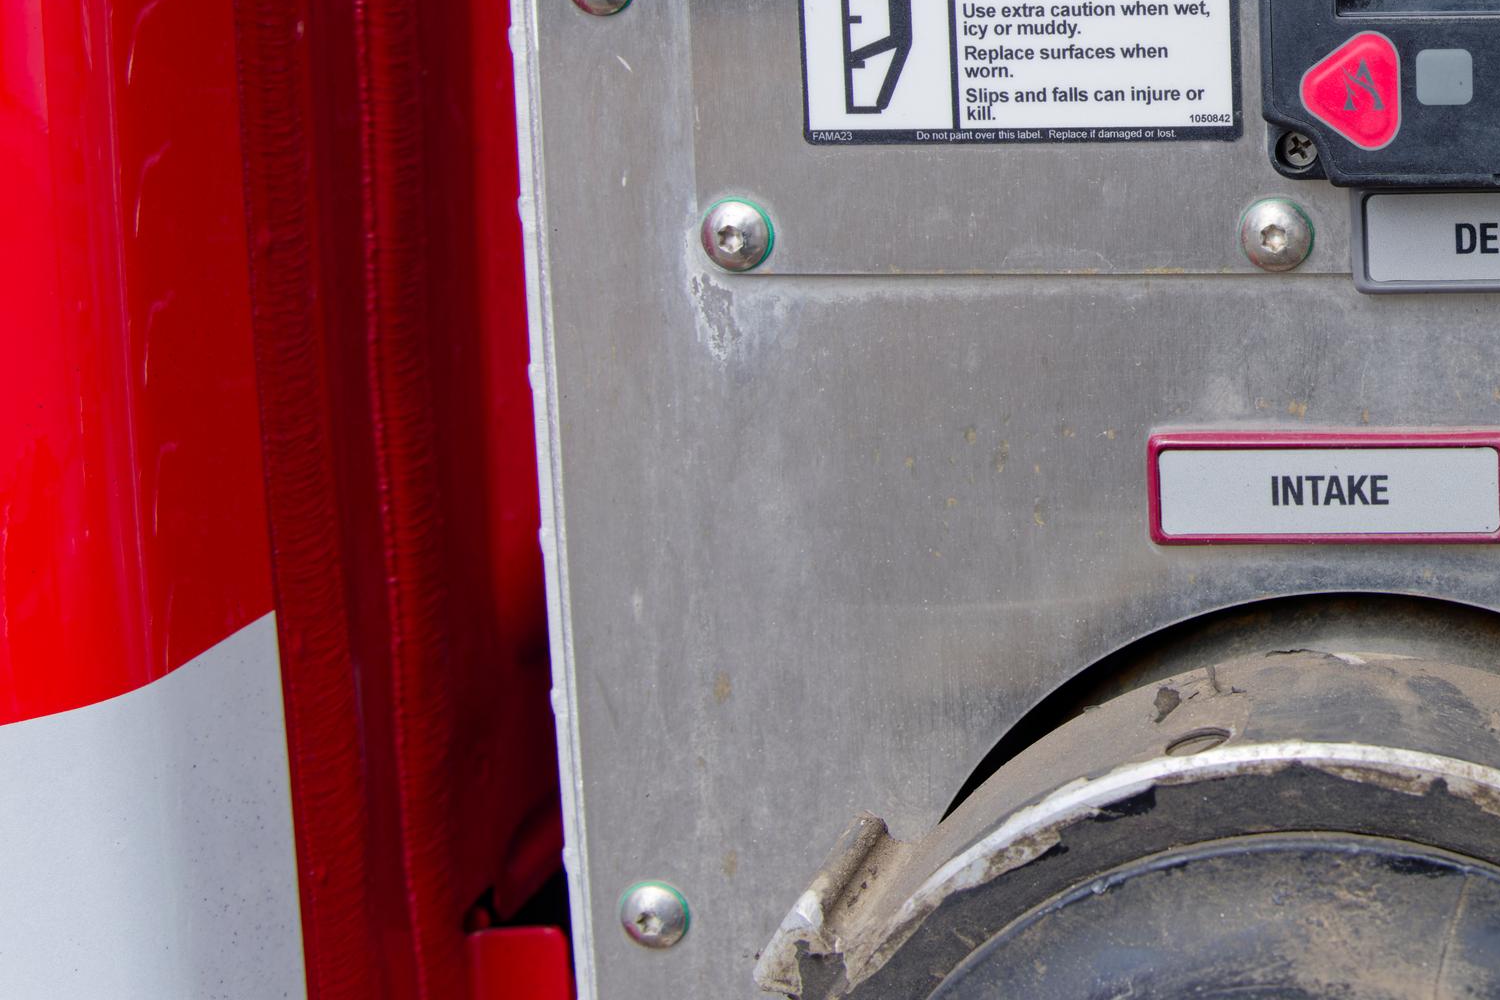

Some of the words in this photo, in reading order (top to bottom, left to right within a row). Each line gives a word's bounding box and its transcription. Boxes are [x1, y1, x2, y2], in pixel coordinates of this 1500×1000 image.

[966, 87, 1009, 107] Slips
[1014, 87, 1046, 102] and
[1052, 86, 1088, 102] falls
[1093, 89, 1124, 101] can
[1130, 85, 1180, 105] injure
[1186, 88, 1204, 100] or
[966, 105, 995, 120] kill.
[1189, 113, 1231, 123] 1050842
[812, 131, 853, 140] FAMA23
[916, 131, 930, 140] Do
[932, 131, 947, 140] not
[949, 130, 972, 142] paint
[974, 132, 995, 140] over
[998, 130, 1015, 139] this
[1017, 130, 1042, 139] label.
[1048, 130, 1087, 141] Replace
[1090, 129, 1095, 139] if
[1098, 129, 1142, 140] damaged
[1157, 129, 1176, 138] lost.
[1271, 474, 1390, 506] INTAKE
